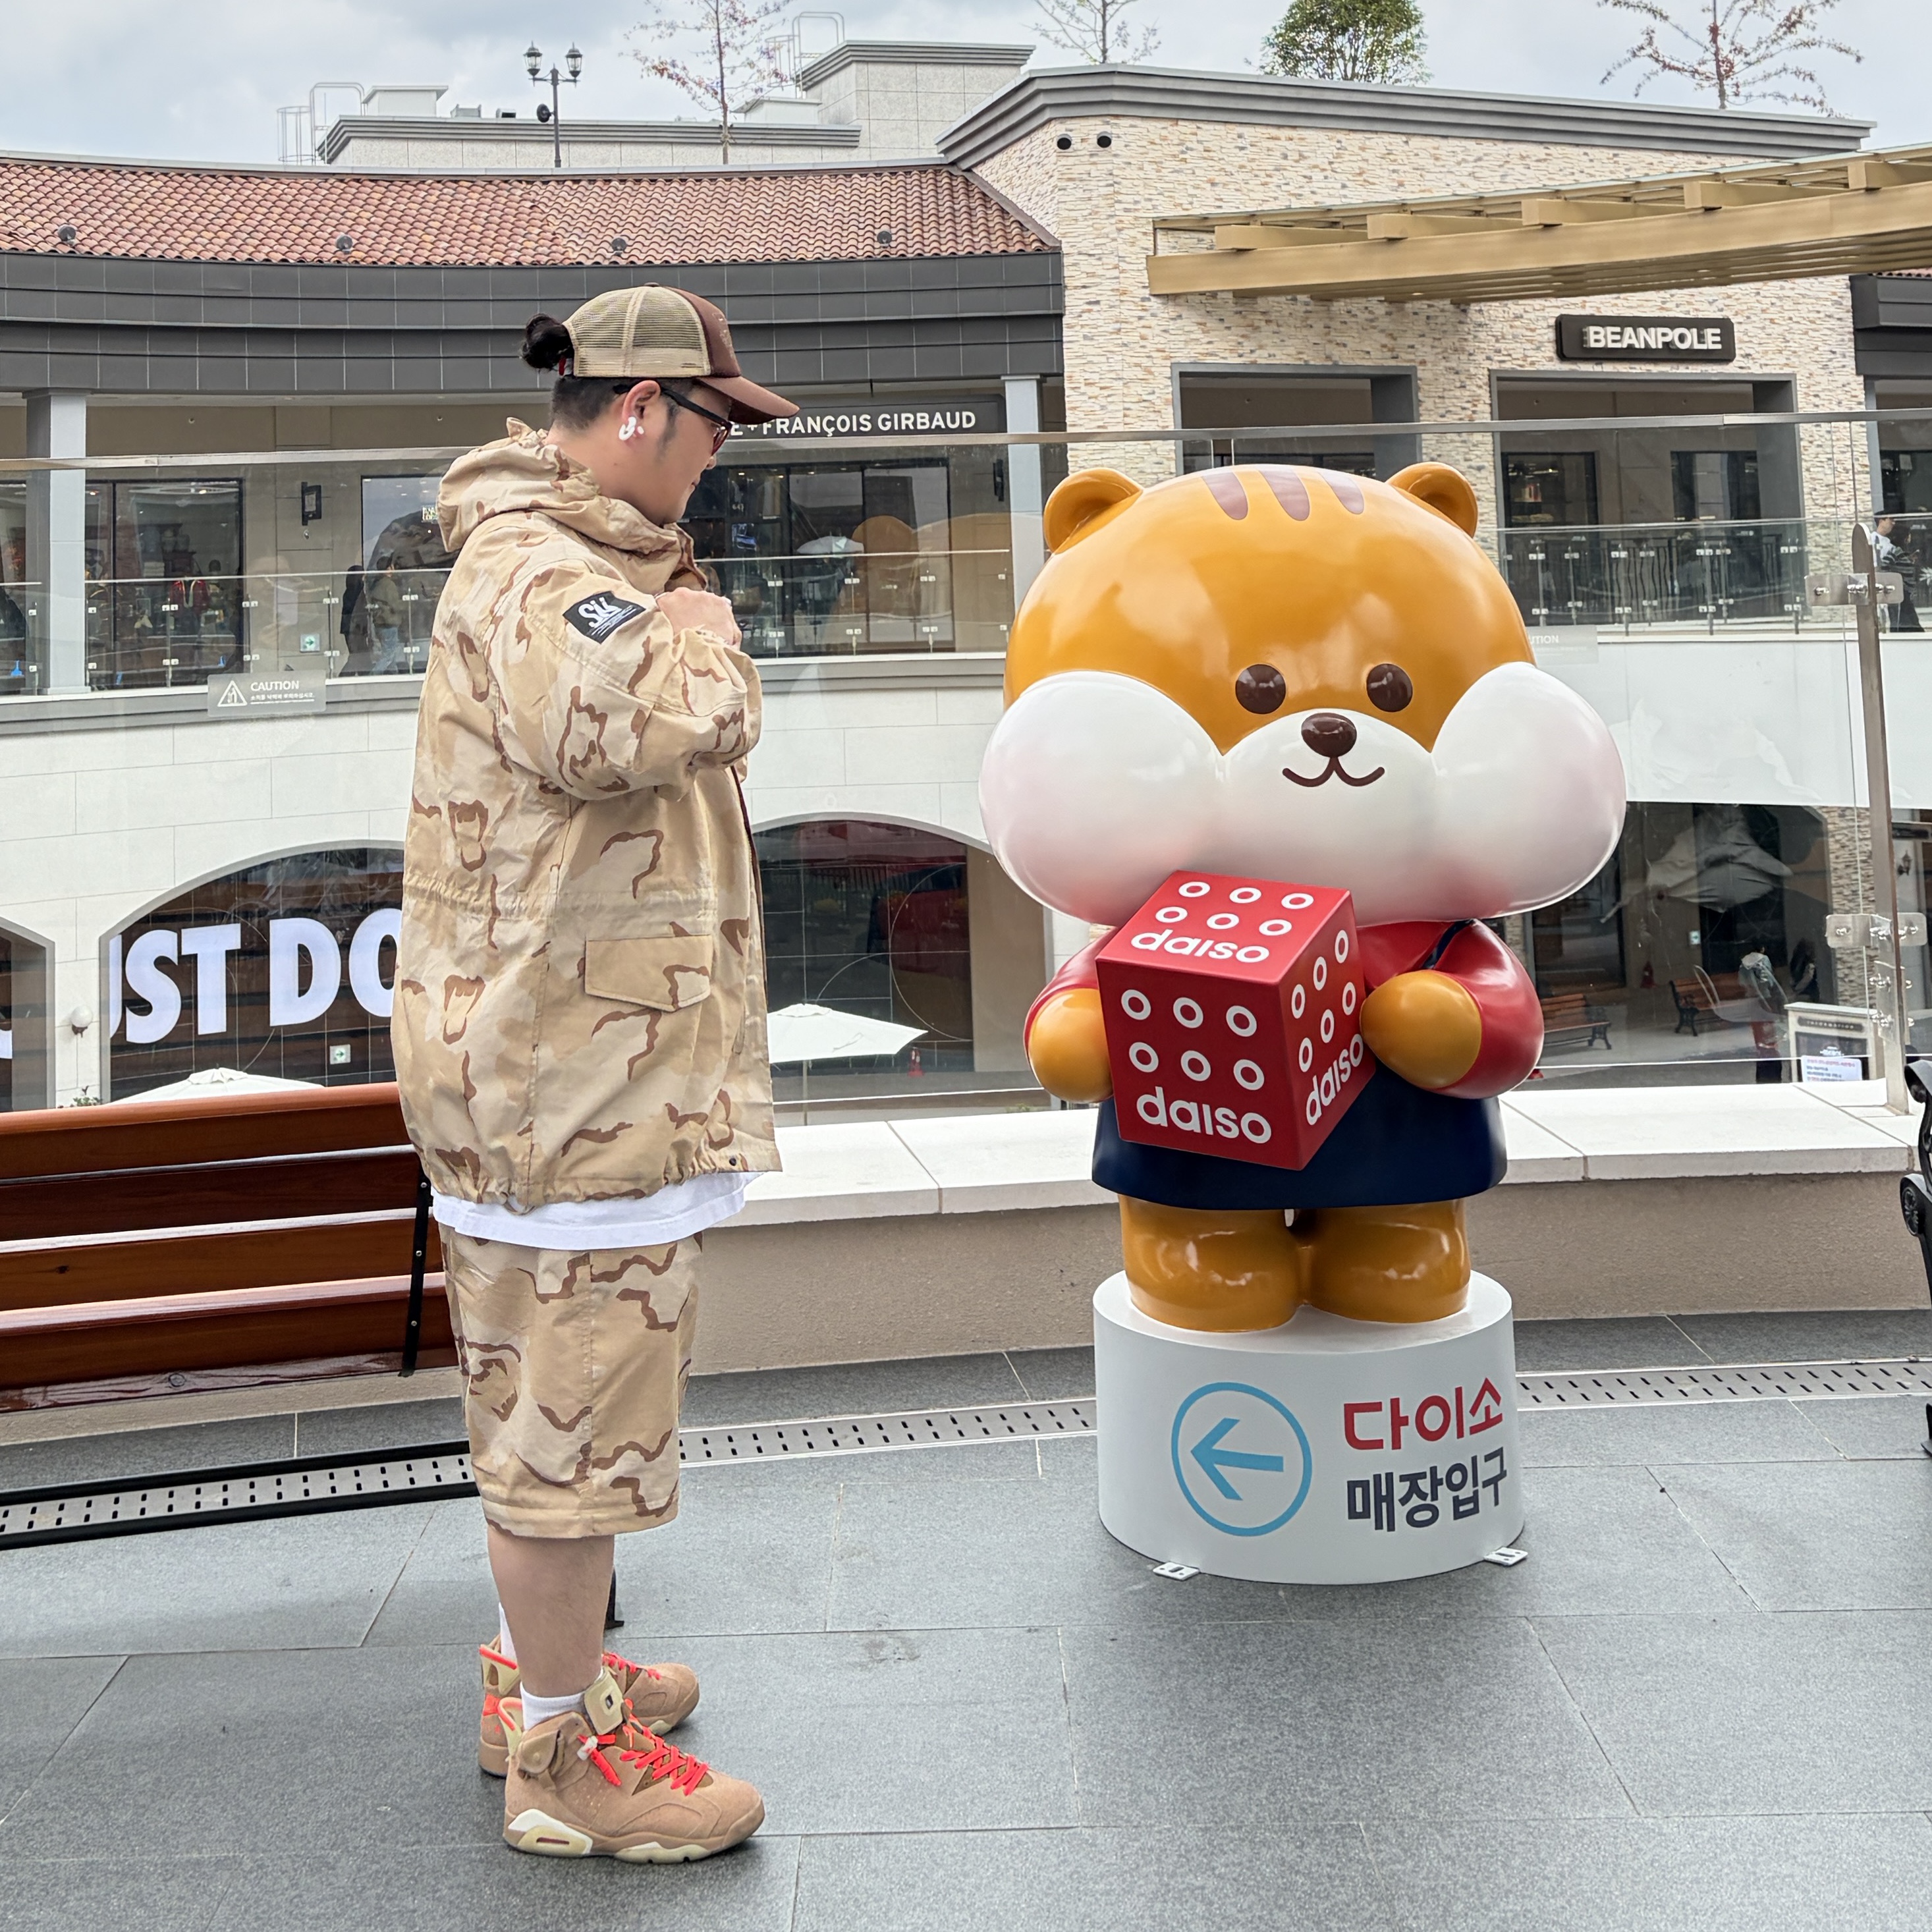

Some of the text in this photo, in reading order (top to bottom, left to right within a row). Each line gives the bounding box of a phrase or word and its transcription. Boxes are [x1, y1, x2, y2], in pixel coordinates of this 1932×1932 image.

[1584, 325, 1723, 350] BEANPOLE
[763, 414, 872, 437] FRANÇOIS
[877, 411, 976, 431] GIRBAUD
[250, 680, 299, 691] CAUTION
[269, 908, 402, 1028] DO
[1130, 929, 1270, 963] daiso
[1306, 1034, 1364, 1126] daiso
[1136, 1086, 1272, 1144] daiso
[1343, 1377, 1503, 1450] 다이소
[1346, 1446, 1508, 1532] 매장입구
